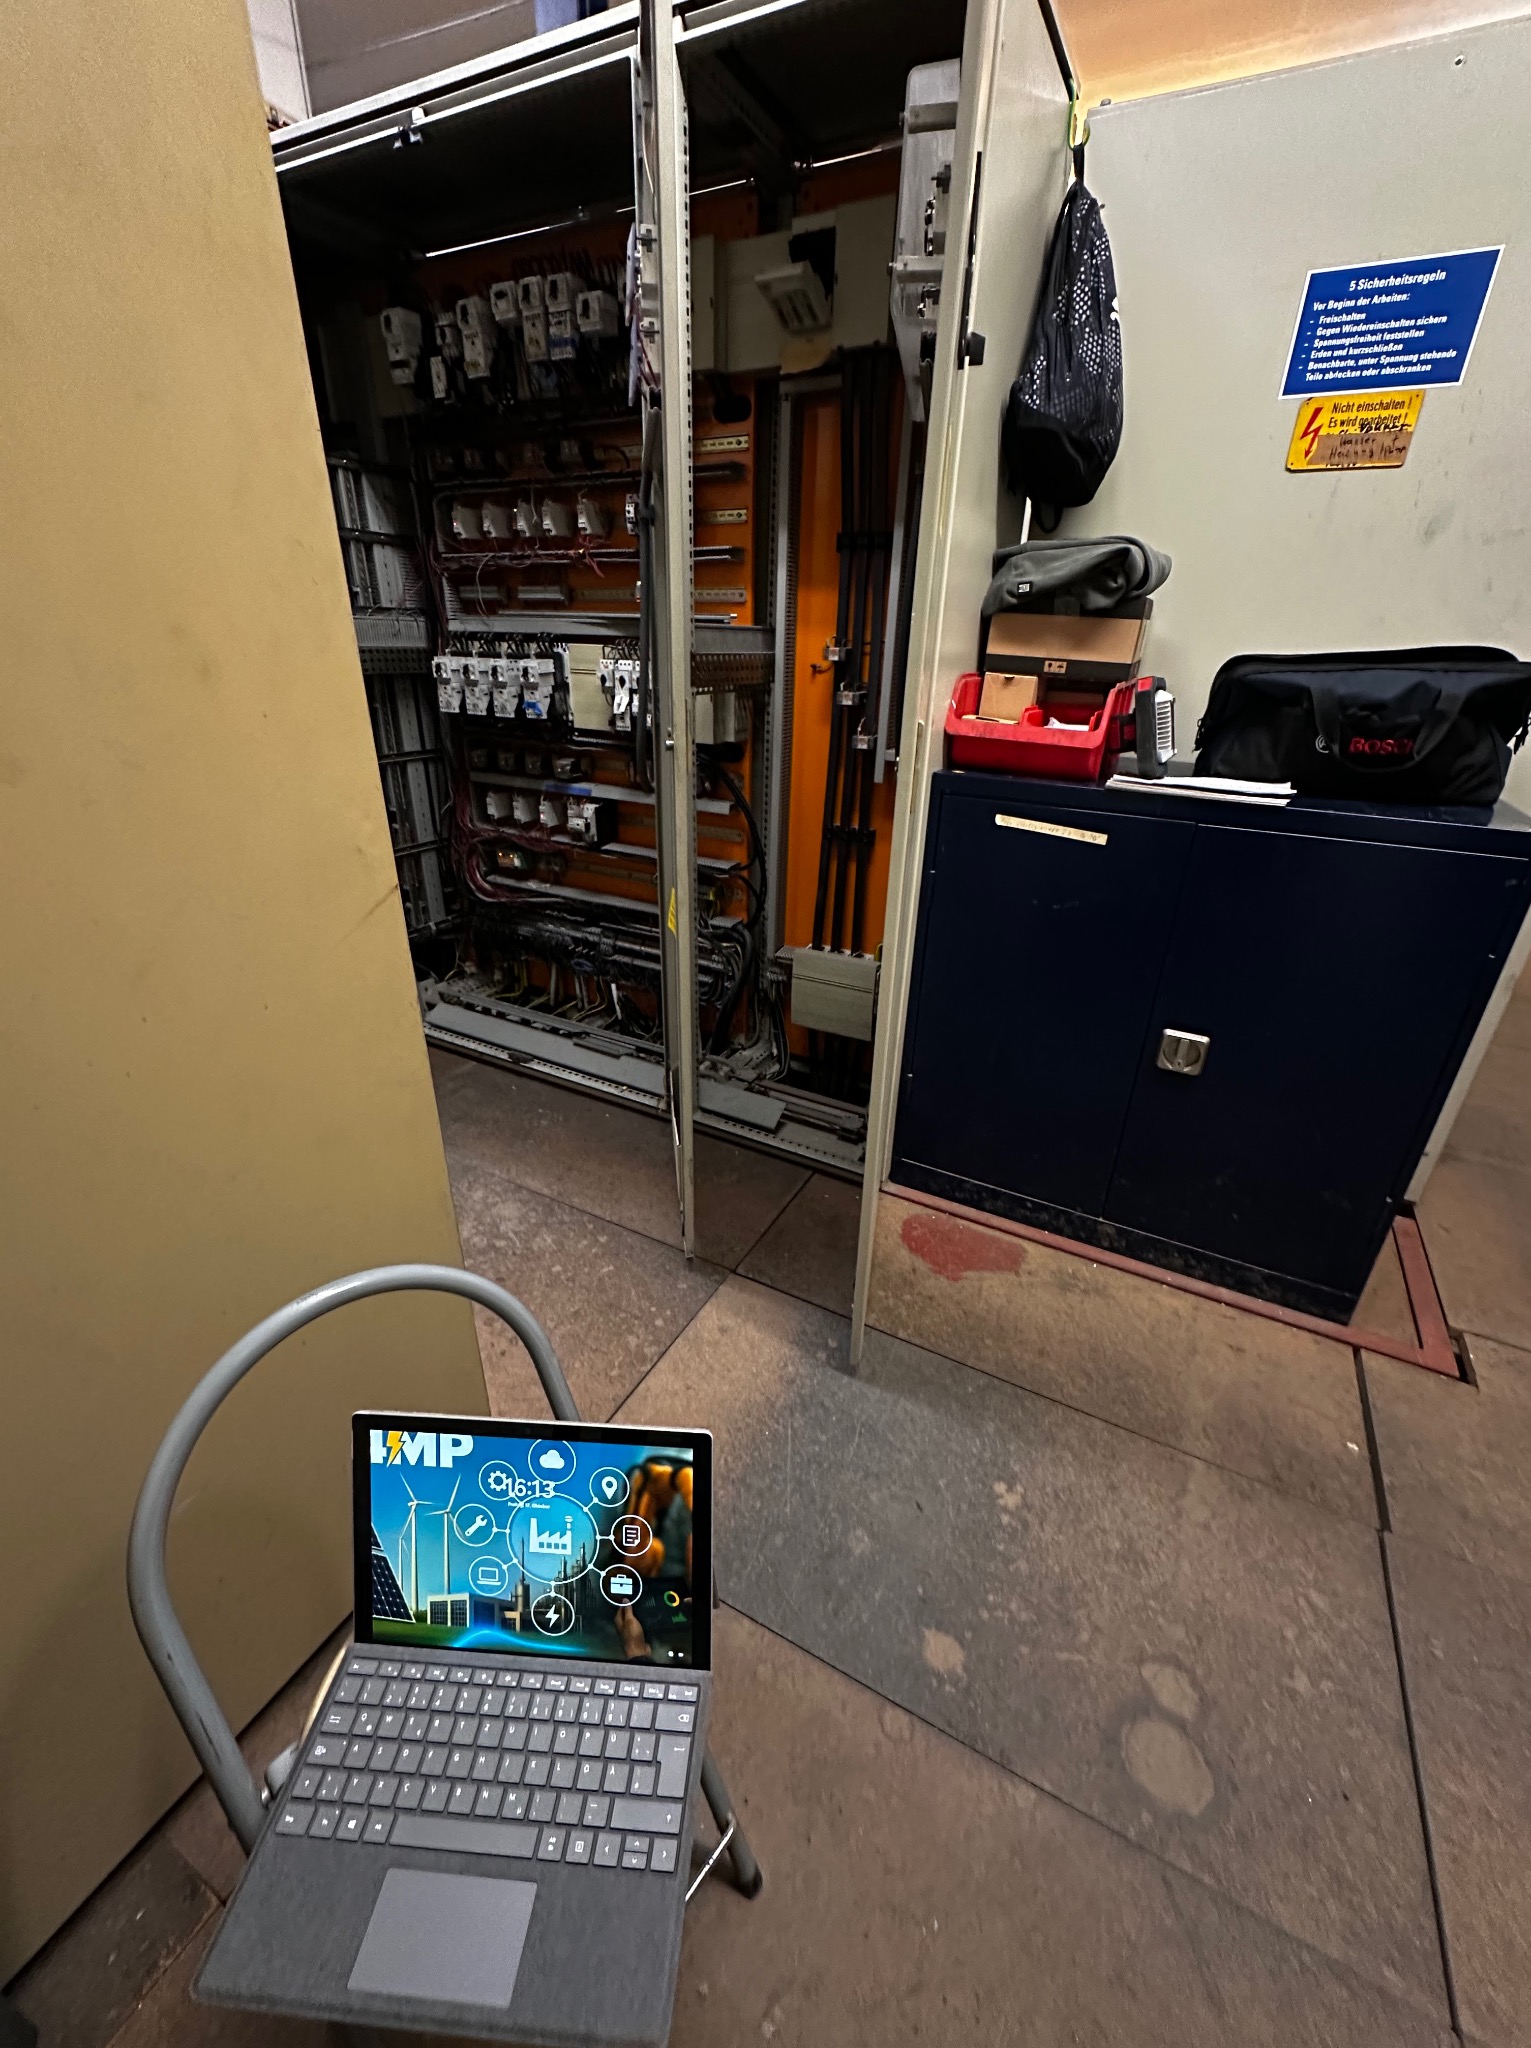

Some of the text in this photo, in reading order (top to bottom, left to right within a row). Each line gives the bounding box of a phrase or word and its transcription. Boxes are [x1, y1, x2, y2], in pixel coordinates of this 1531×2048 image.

[1348, 269, 1447, 291] 5 Sicherheitsregeln
[1313, 292, 1411, 312] Vor Beginn der Arbeiten:
[1316, 315, 1448, 336] Gegen Wiedereinschalten sichern
[1318, 312, 1366, 324] Freischalten
[1313, 329, 1425, 349] Spannungsfreiheit feststellen
[1310, 350, 1332, 359] Erden
[1333, 348, 1348, 357] und
[1358, 357, 1379, 366] unter
[1380, 354, 1419, 366] Spannung
[1420, 349, 1457, 360] stehende
[1305, 363, 1432, 381] Teile abdecken oder abschranken
[1331, 402, 1354, 414] Nicht
[1356, 399, 1406, 413] einschalten
[1328, 417, 1338, 428] Es
[1339, 414, 1358, 427] wird
[505, 1478, 555, 1498] 16:13
